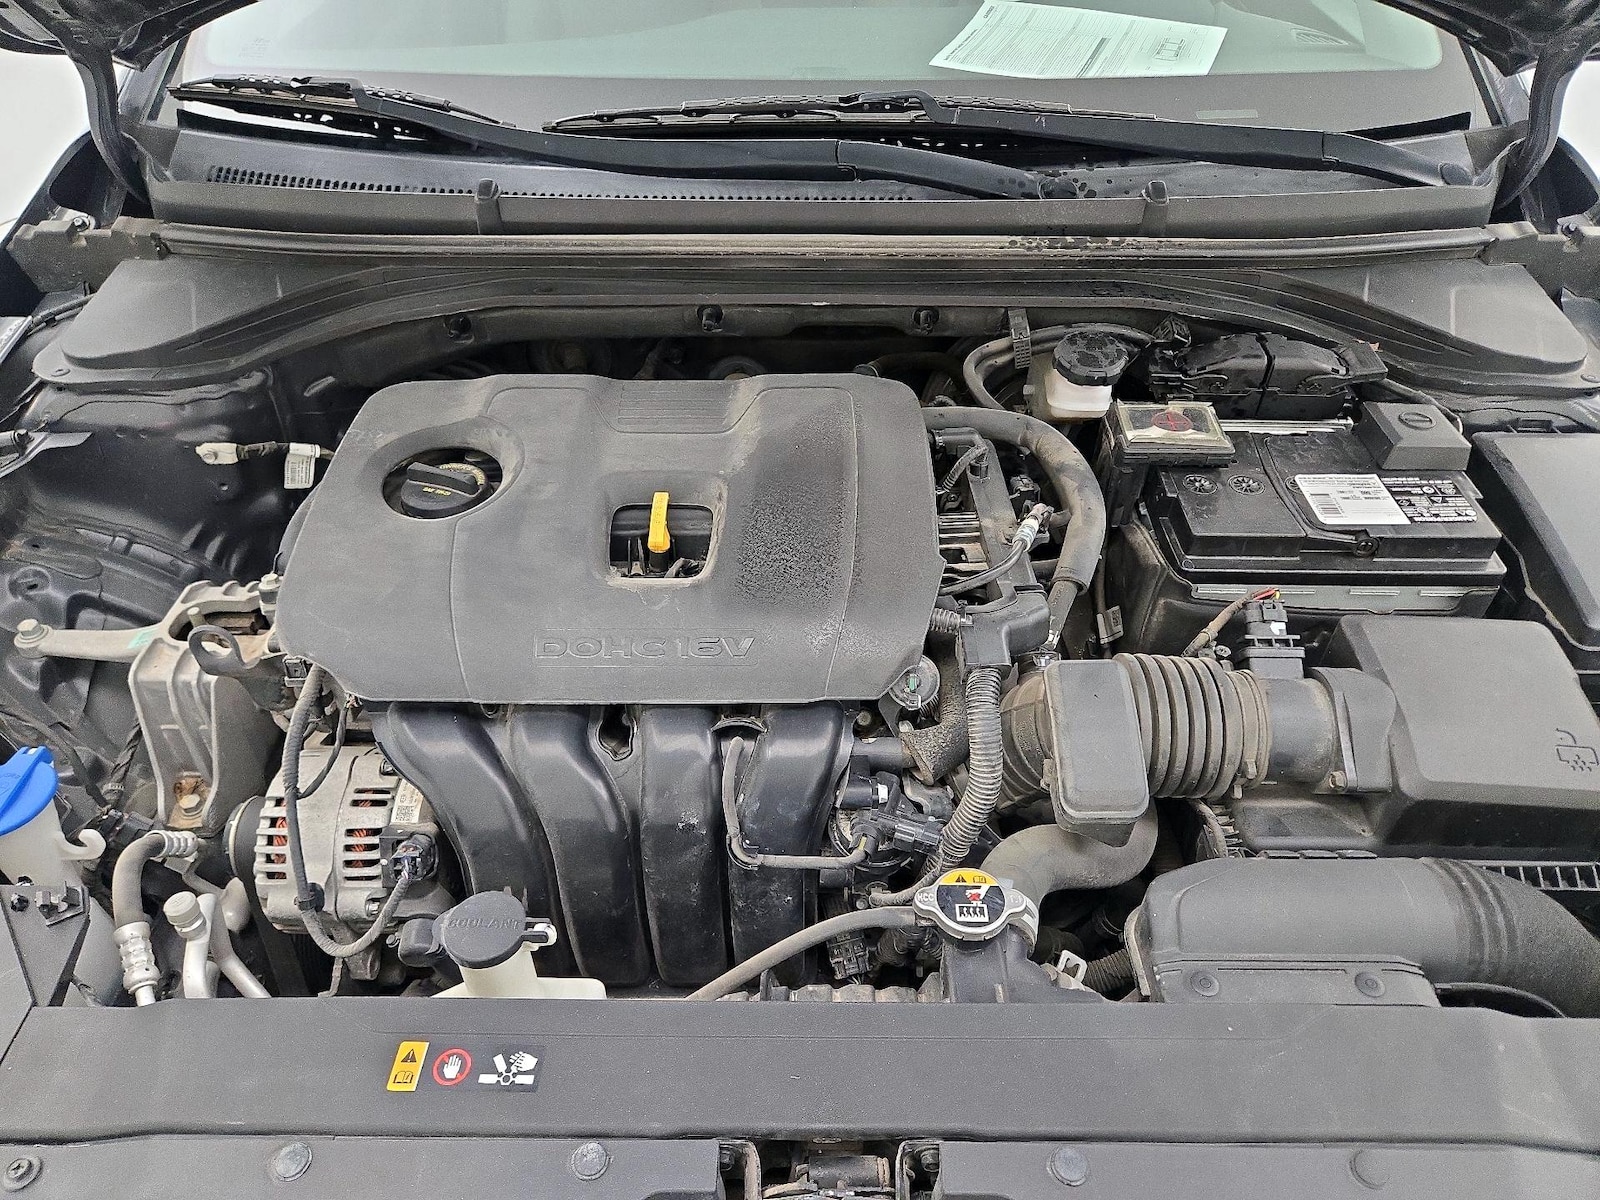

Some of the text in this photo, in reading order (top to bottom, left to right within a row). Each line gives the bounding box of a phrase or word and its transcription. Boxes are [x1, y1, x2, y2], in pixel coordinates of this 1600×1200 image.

[534, 636, 756, 659] DOHC 16V
[917, 892, 935, 903] HCC
[446, 917, 521, 931] COOLANT
